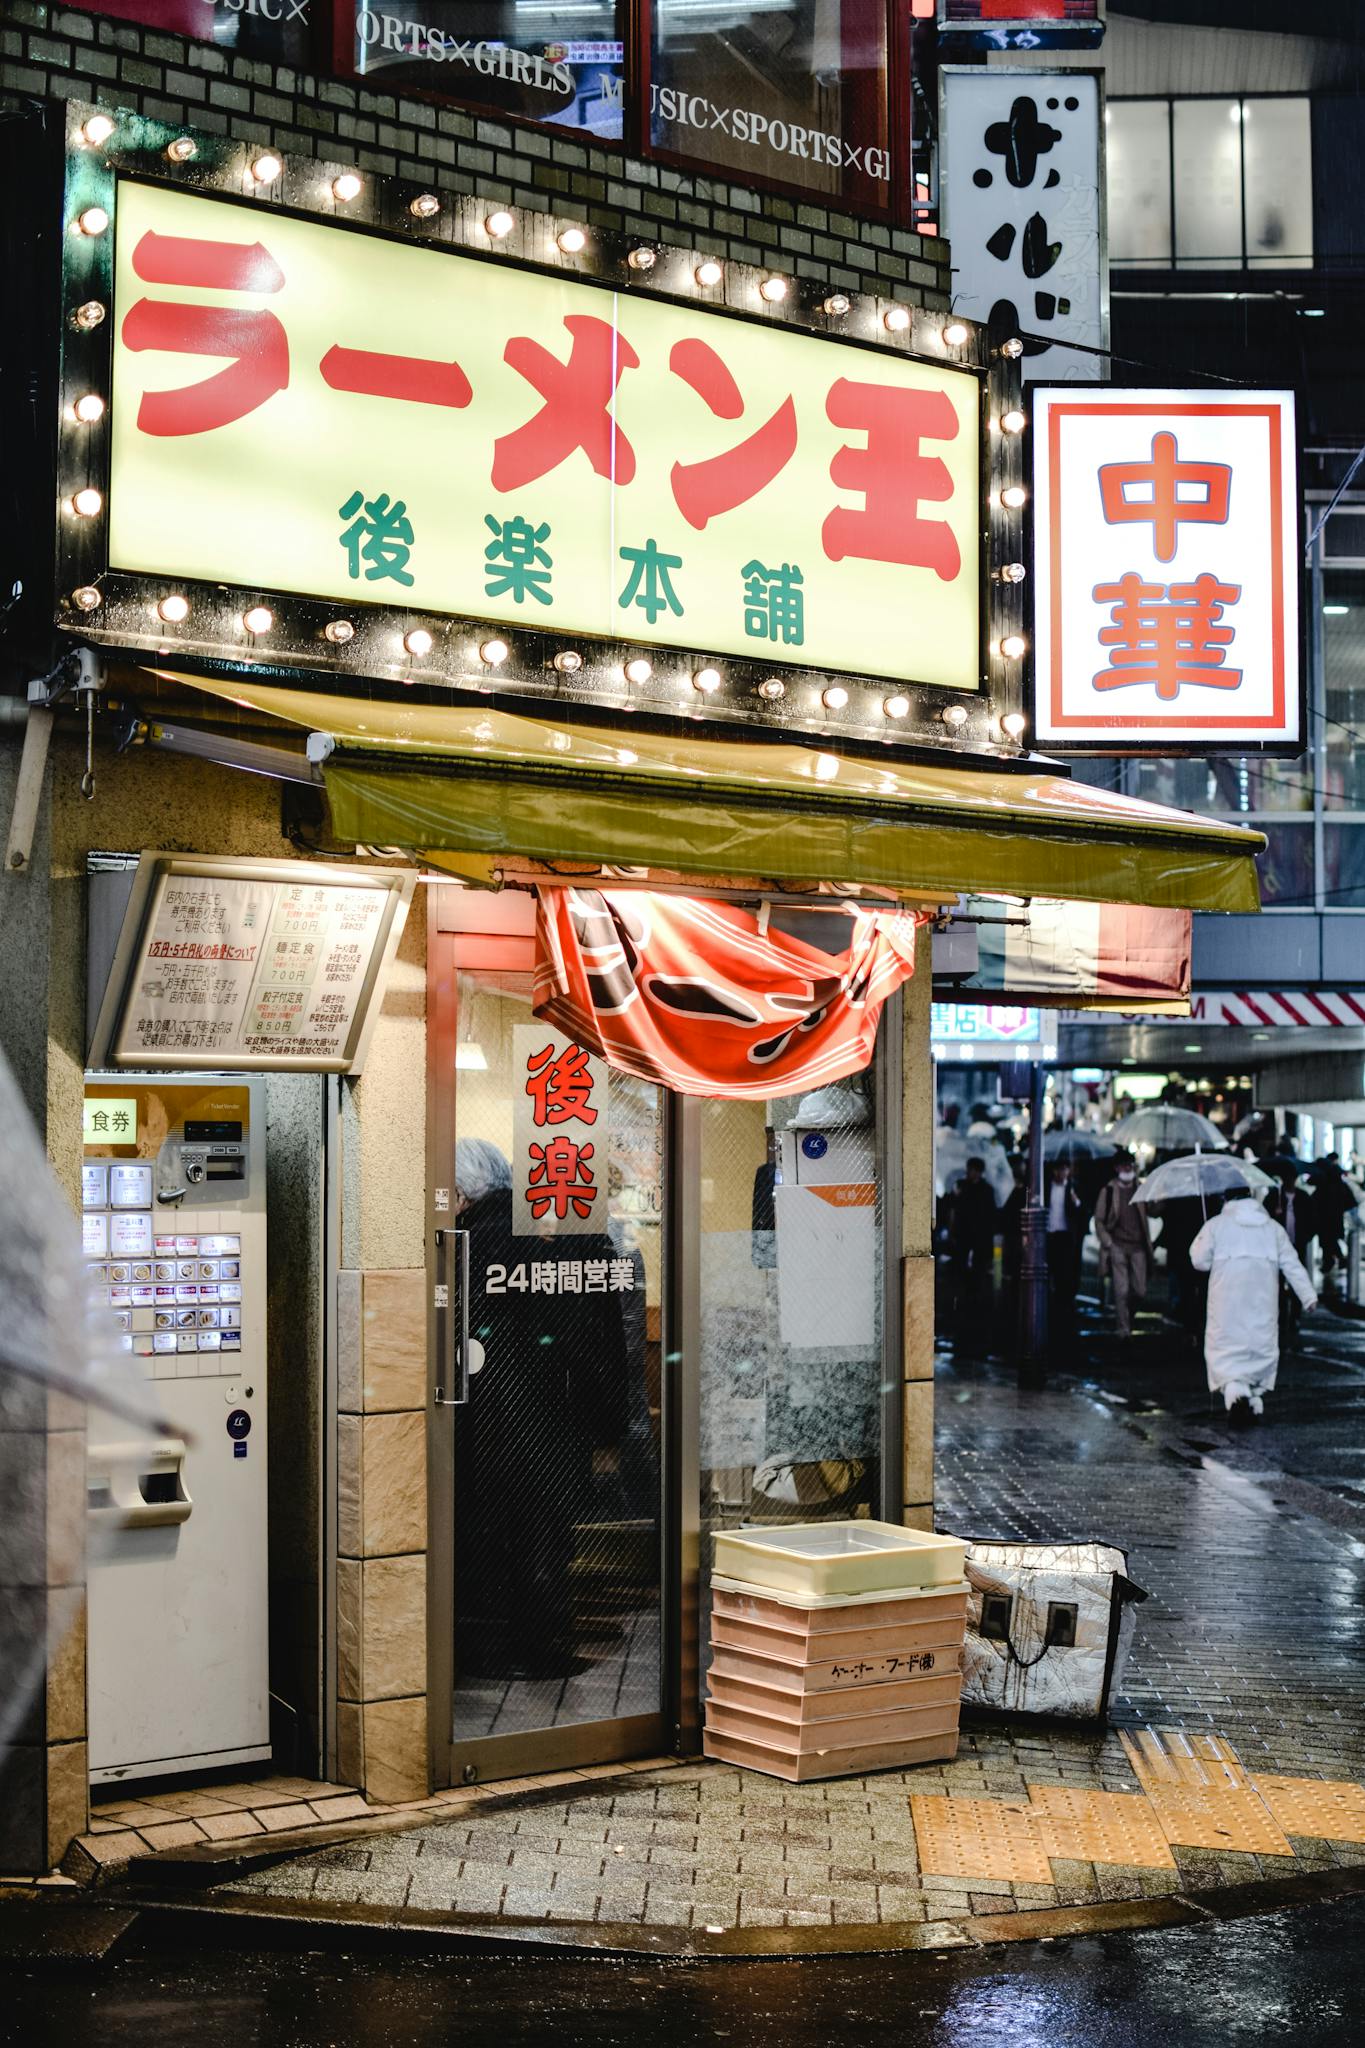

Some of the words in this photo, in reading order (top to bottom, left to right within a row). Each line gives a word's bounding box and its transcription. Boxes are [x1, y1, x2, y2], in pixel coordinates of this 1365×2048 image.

[121, 229, 962, 582] ラーメン王
[338, 491, 805, 647] 後楽本舗
[1091, 431, 1244, 701] 中華
[271, 970, 306, 981] 700円
[262, 991, 304, 1004] 餃子付定食
[257, 1021, 292, 1032] 850円
[92, 1110, 130, 1132] 食券
[525, 1043, 598, 1220] 後楽
[485, 1258, 635, 1295] 24時間営業
